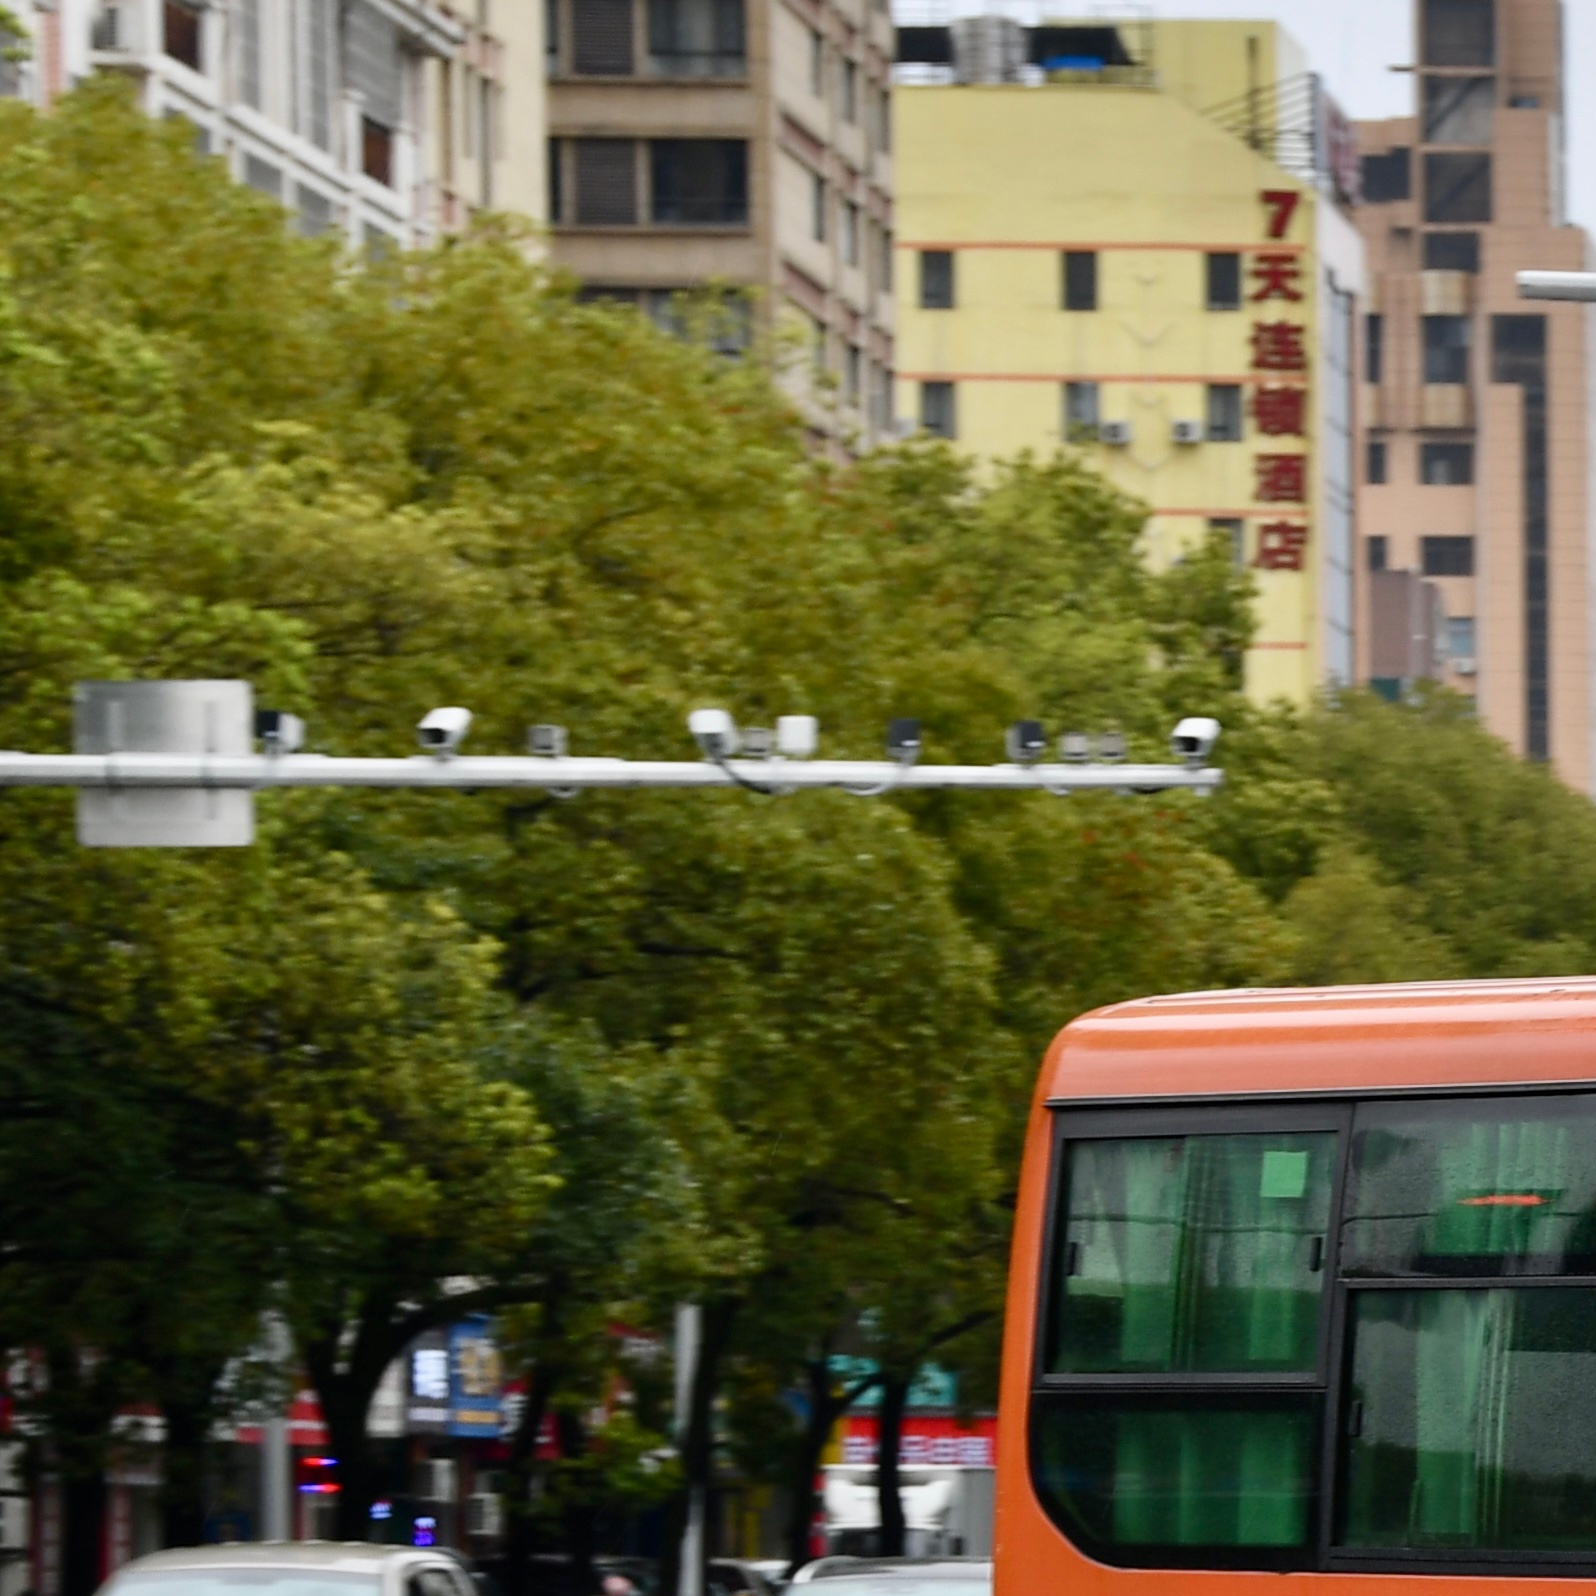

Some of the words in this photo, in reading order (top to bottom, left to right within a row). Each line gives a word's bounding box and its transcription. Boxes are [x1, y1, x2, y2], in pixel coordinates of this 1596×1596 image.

[1249, 189, 1309, 572] 7天连锁酒店
